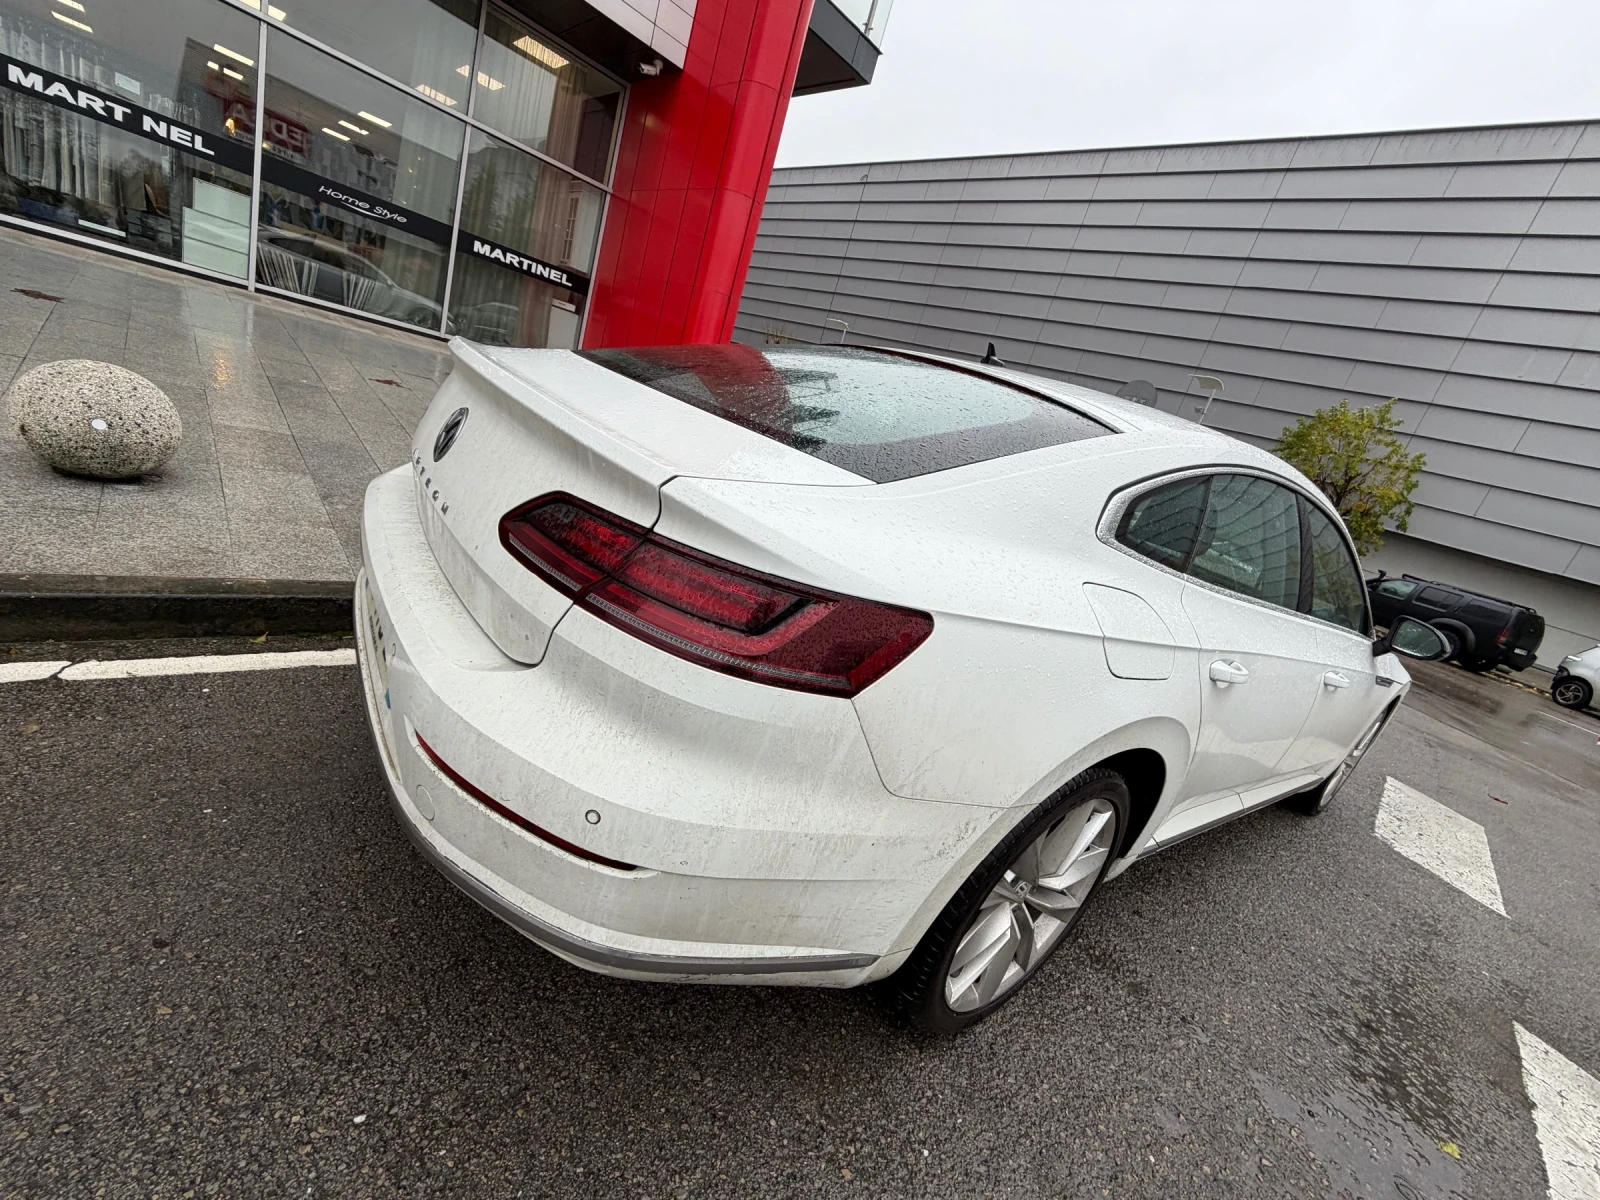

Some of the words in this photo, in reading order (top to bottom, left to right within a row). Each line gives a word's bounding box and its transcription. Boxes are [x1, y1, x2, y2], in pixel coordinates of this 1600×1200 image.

[318, 185, 371, 209] Home
[373, 205, 408, 223] Style
[473, 239, 573, 287] MARTINEL
